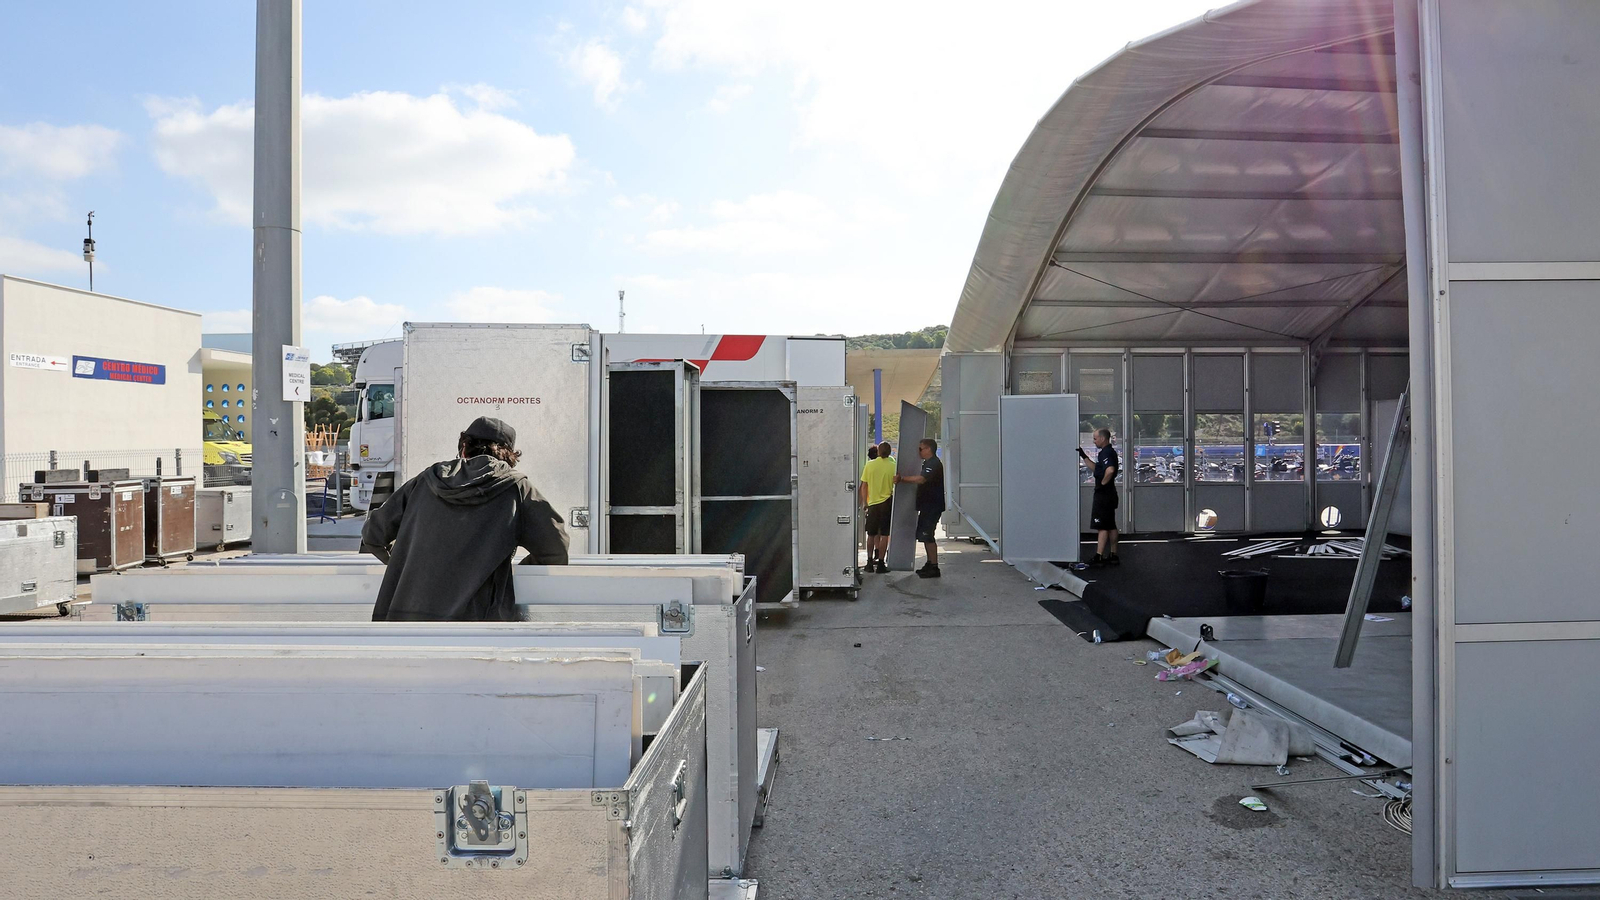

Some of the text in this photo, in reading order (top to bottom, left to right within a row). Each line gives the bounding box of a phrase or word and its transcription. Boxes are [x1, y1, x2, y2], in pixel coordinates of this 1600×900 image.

[10, 353, 46, 363] ENTRADA
[102, 361, 131, 373] CENTRO
[109, 372, 153, 383] MEDICAL CENTER
